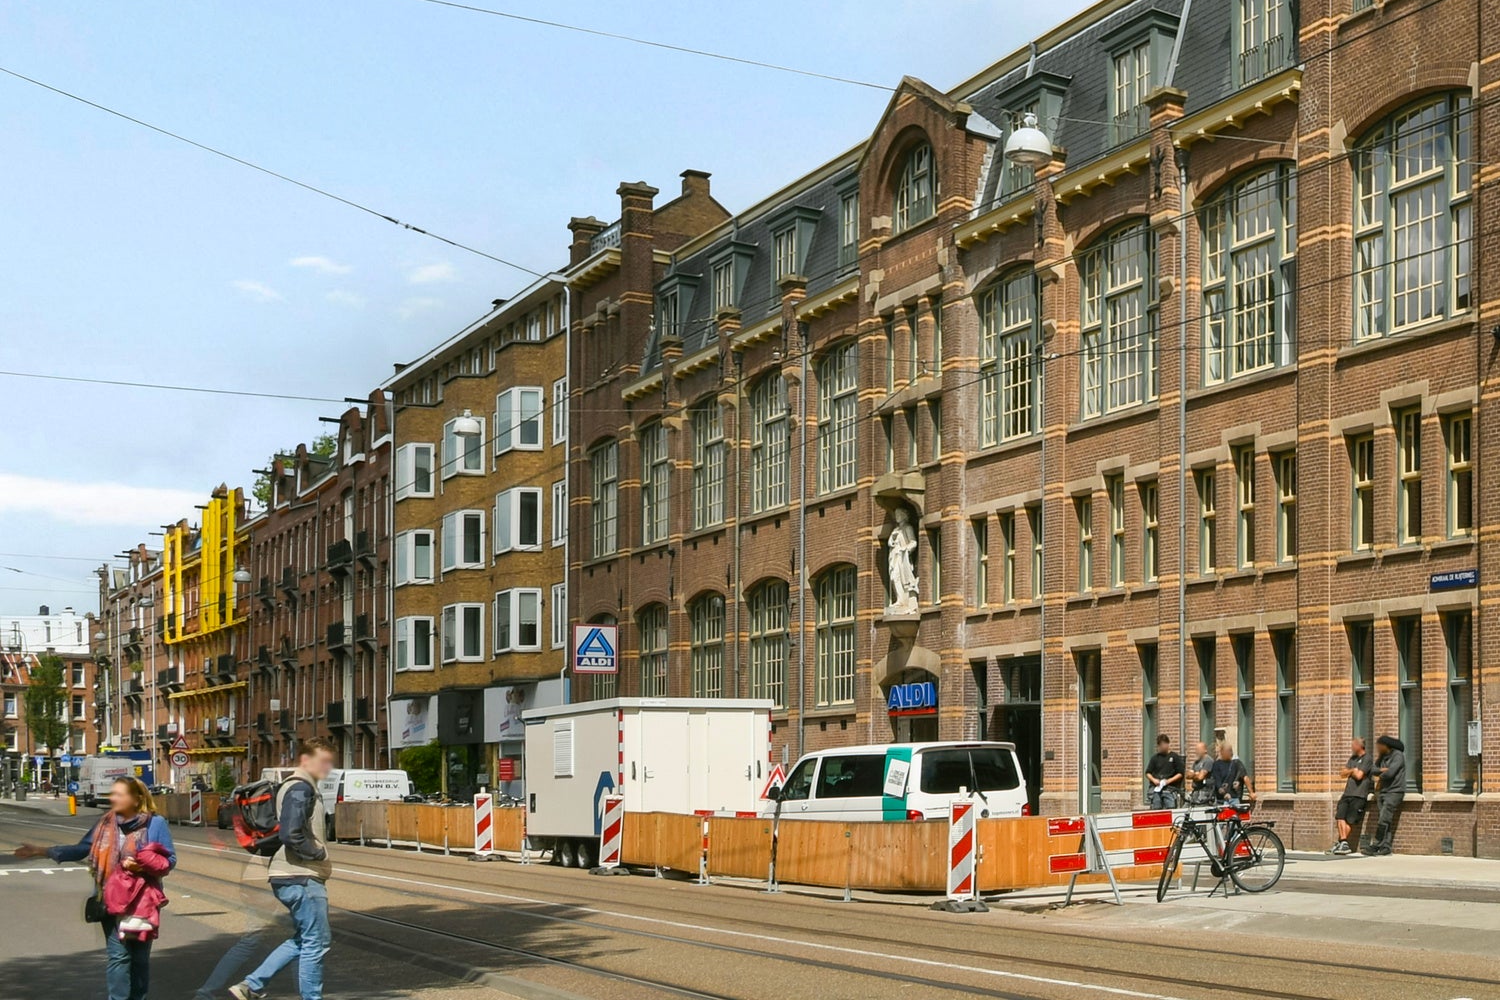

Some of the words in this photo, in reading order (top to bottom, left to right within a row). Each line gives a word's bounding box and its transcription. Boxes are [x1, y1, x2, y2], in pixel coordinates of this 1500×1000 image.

[580, 657, 612, 666] ALDI
[887, 681, 934, 709] ALDI
[174, 755, 186, 763] 30
